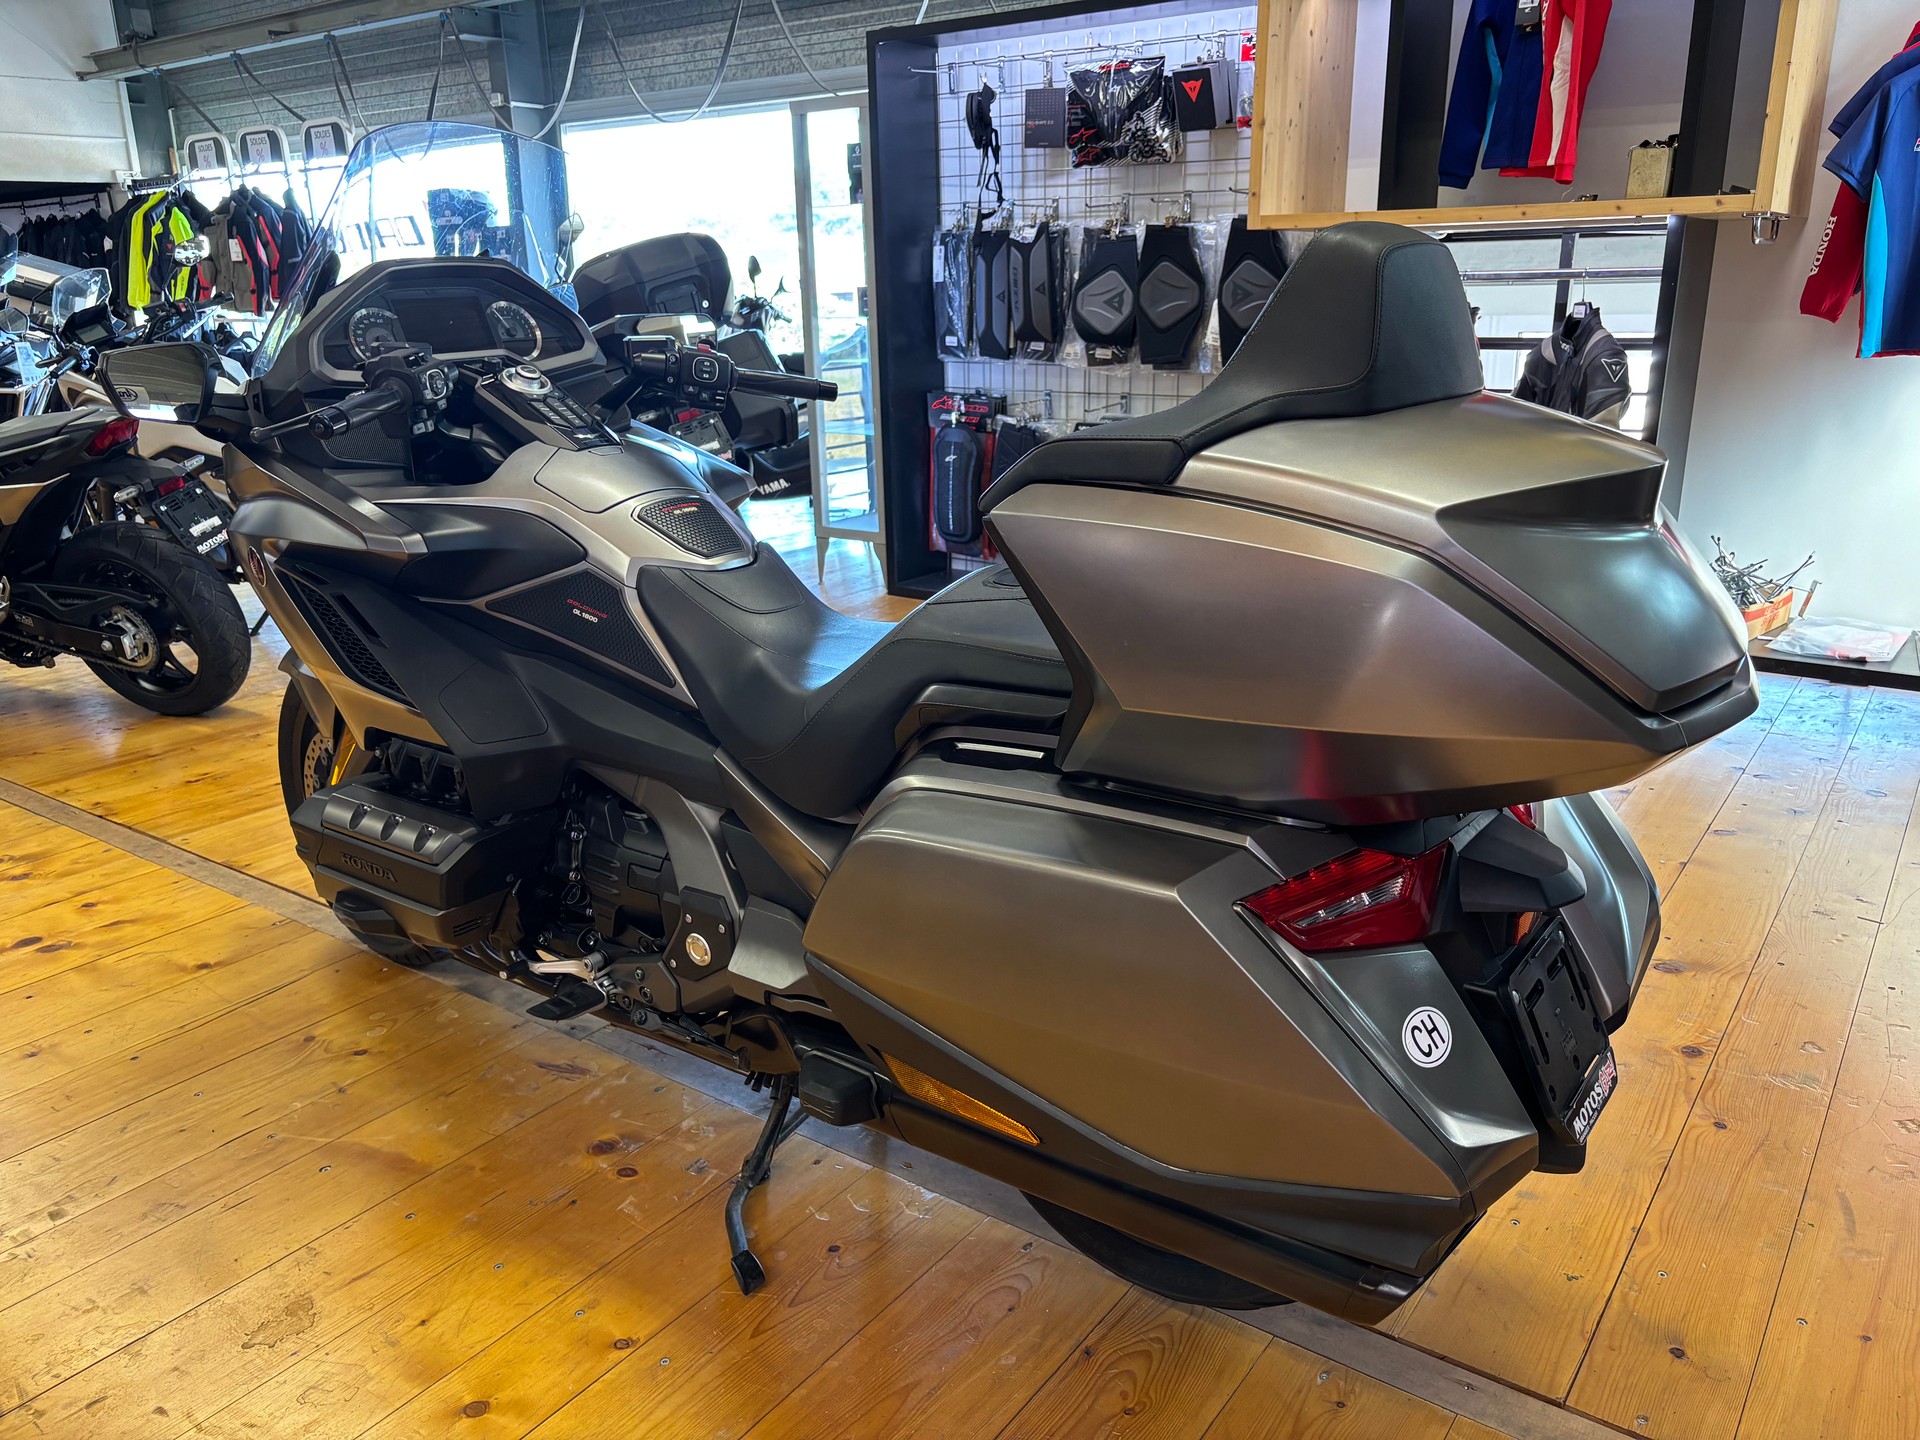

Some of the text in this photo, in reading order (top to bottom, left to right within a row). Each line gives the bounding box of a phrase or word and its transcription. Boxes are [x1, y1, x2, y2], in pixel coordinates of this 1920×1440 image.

[249, 136, 267, 146] SOLDES
[313, 129, 331, 139] SOLDES
[197, 143, 213, 153] SOLDES
[255, 148, 265, 162] %
[203, 154, 211, 169] %
[1808, 215, 1838, 276] HONDA
[196, 532, 226, 553] MOTOS
[567, 599, 608, 619] GOLDWING
[339, 851, 398, 882] HONDA
[1410, 1013, 1446, 1058] CH
[1572, 1081, 1604, 1140] MOTOS
